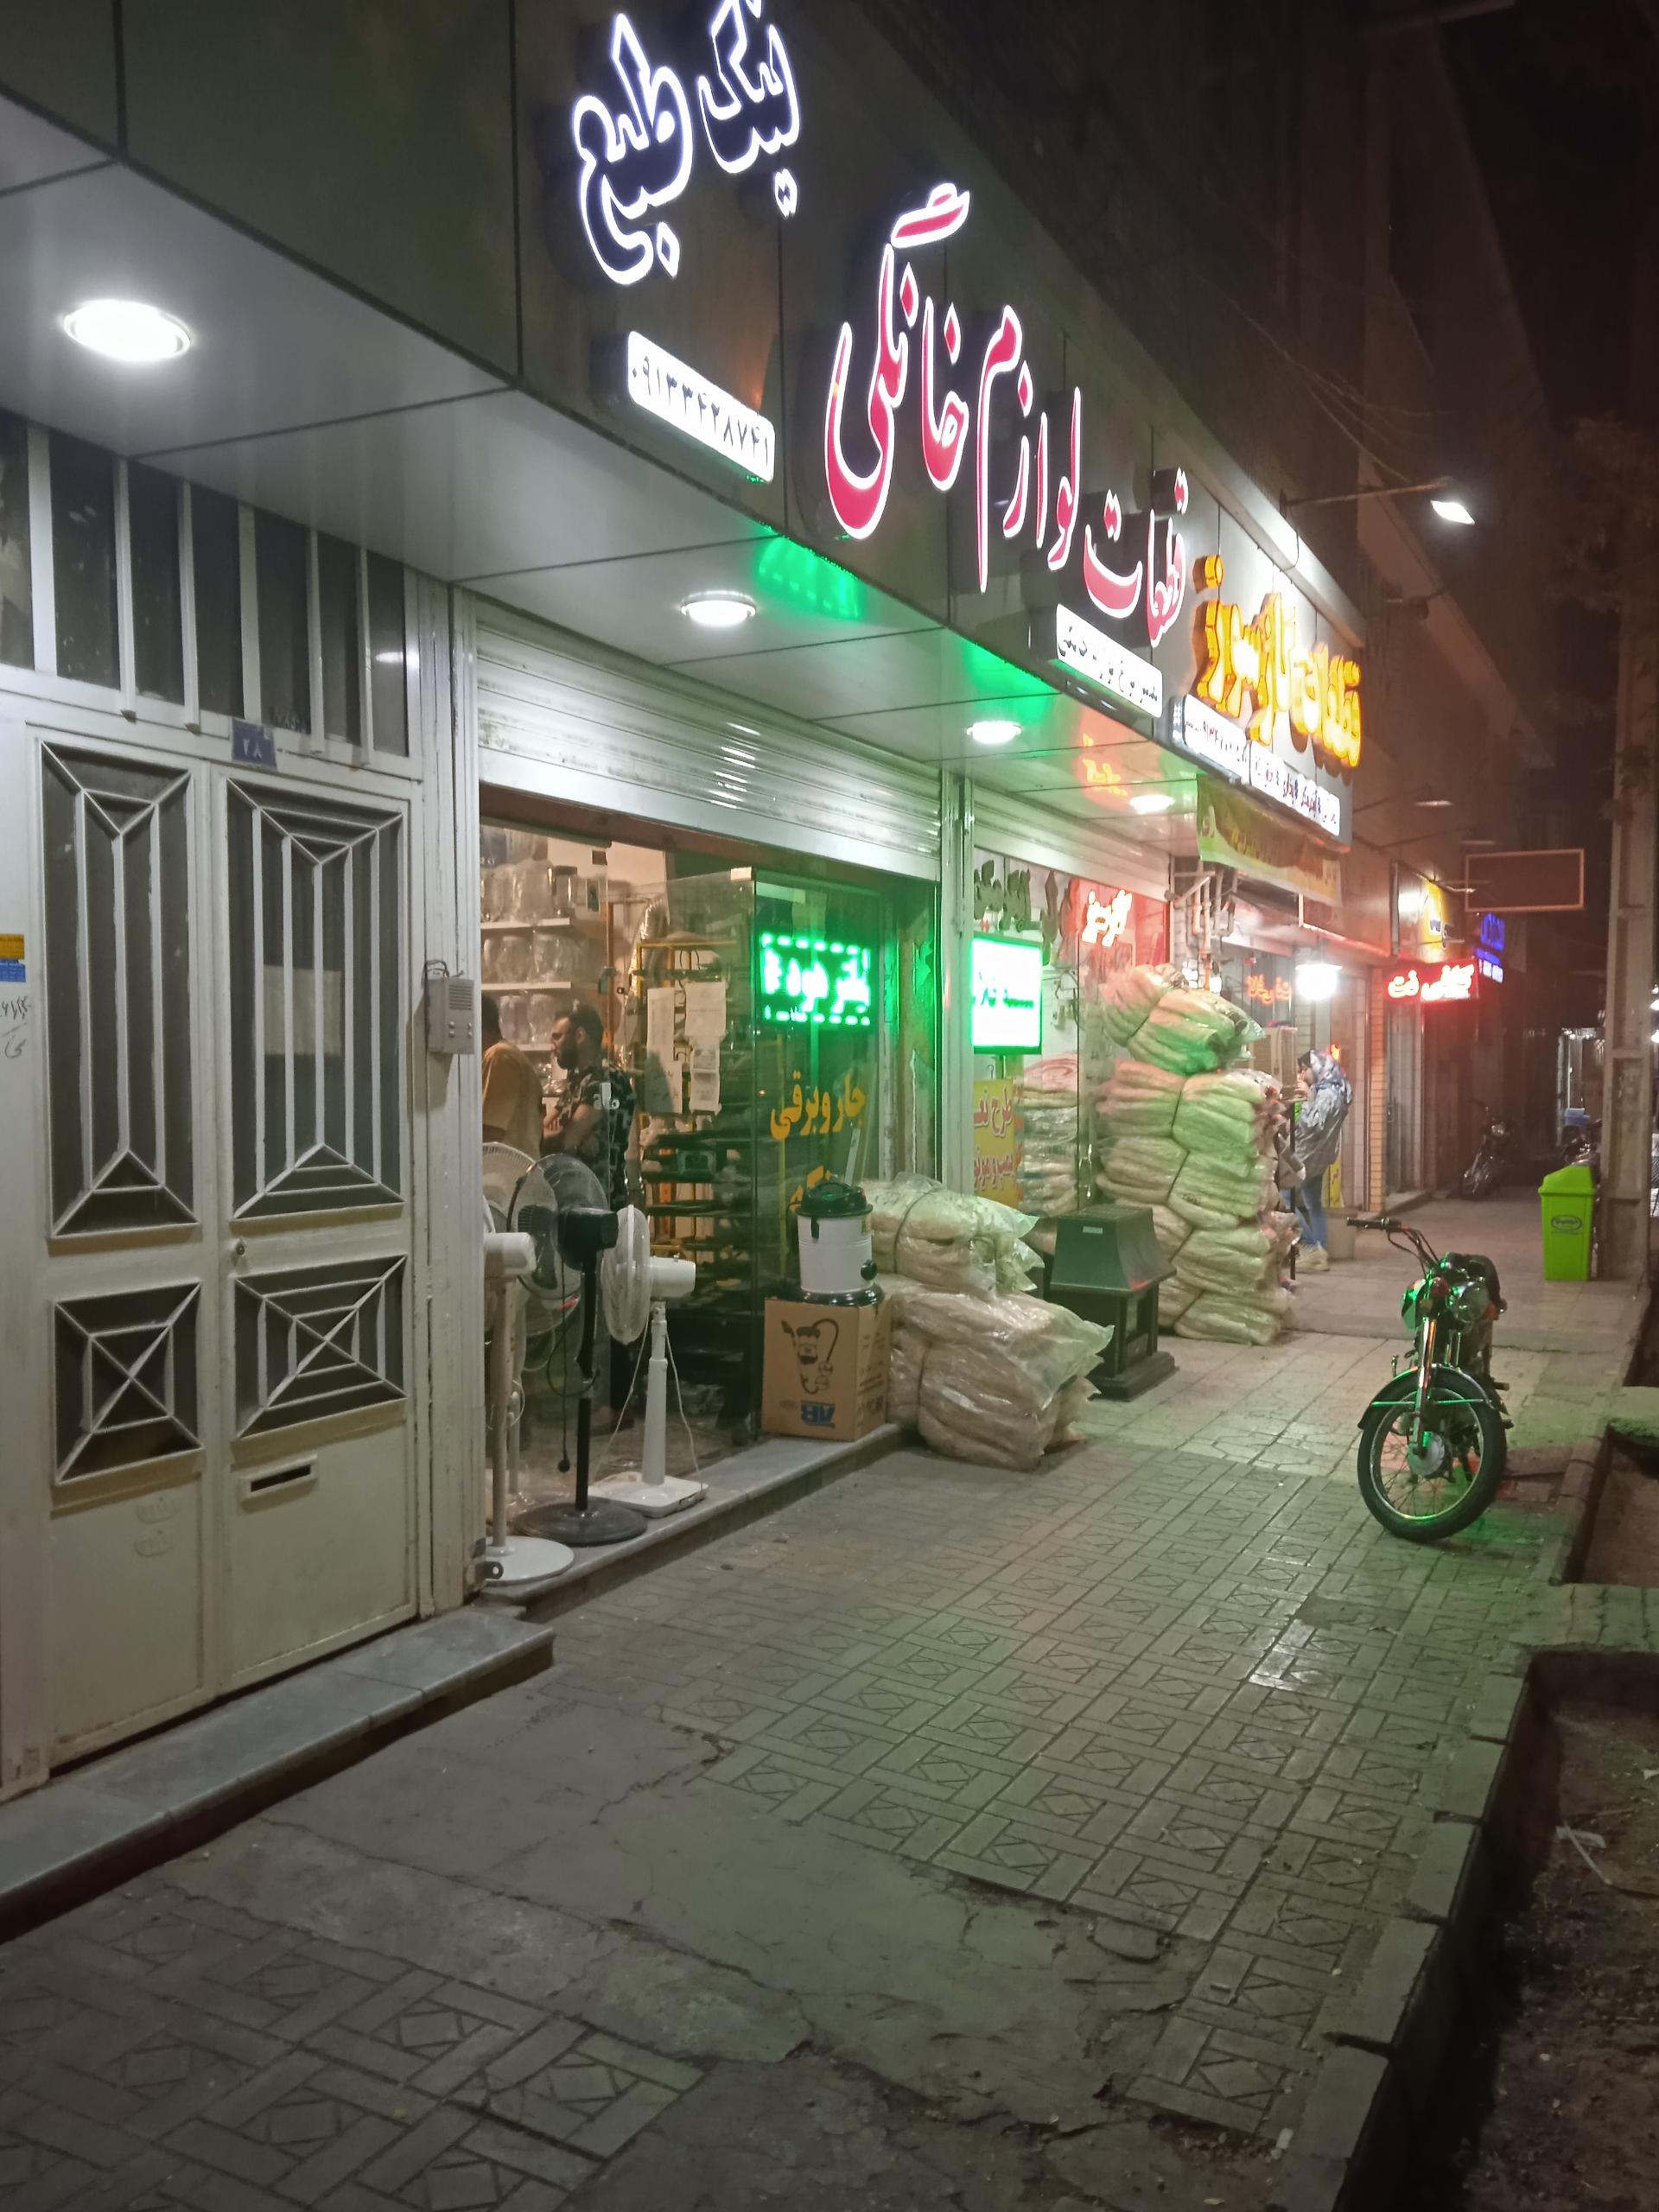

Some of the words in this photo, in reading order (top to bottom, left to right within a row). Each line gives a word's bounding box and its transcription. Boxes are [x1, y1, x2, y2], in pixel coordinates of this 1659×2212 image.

[632, 355, 768, 467] ۰۹۱۳۳۴۲۸۷۴۱
[824, 181, 971, 540] خانگی
[976, 304, 1082, 594] لوازم
[1082, 467, 1189, 649] قطعات
